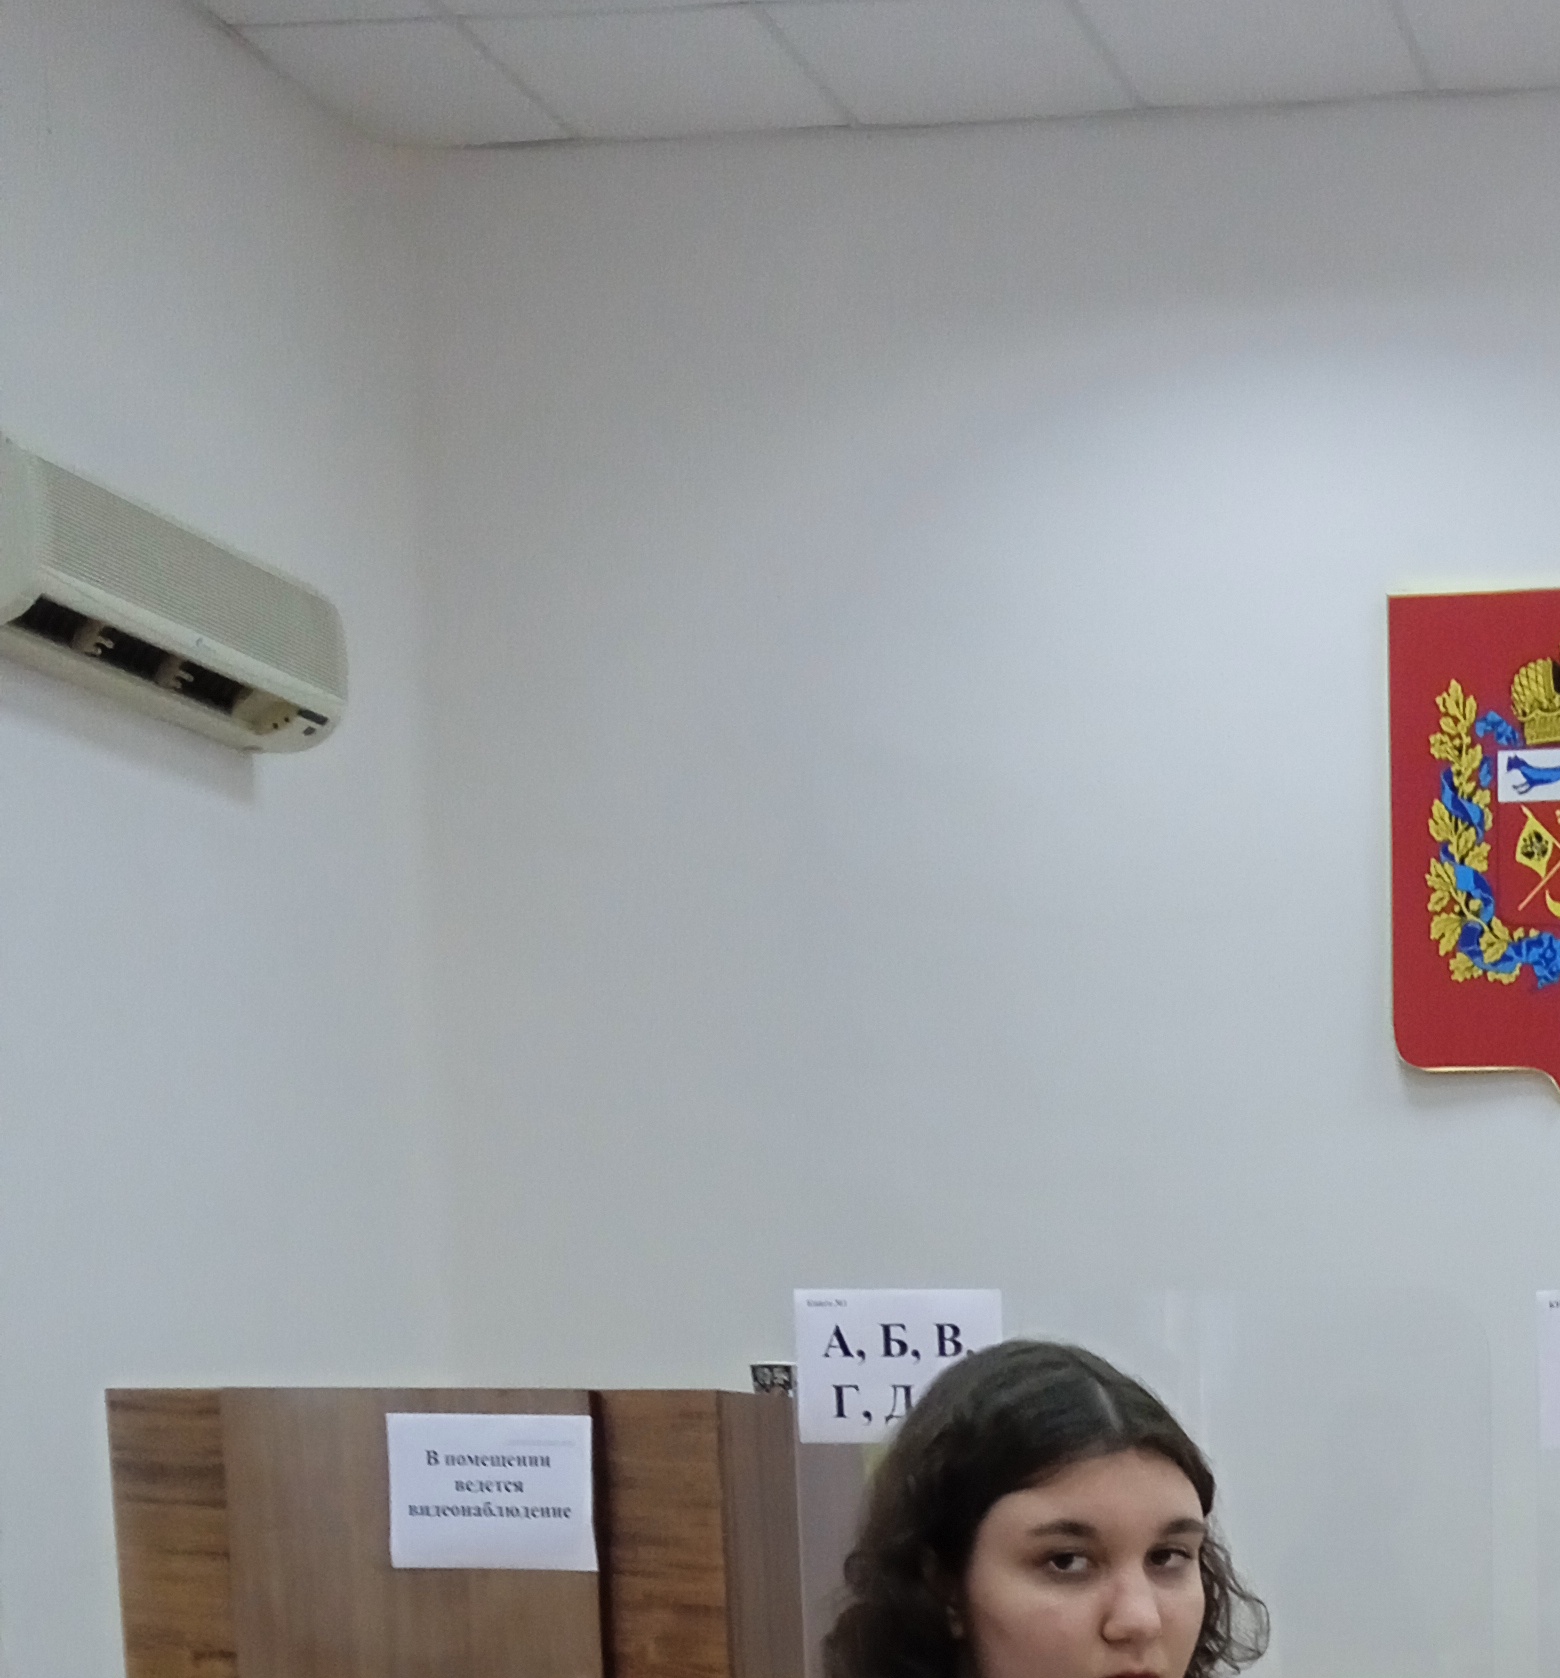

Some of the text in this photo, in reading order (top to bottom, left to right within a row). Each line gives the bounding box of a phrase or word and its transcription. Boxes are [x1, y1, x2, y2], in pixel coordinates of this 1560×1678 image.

[426, 1450, 552, 1469] В помещении
[454, 1479, 525, 1494] ведется
[408, 1501, 573, 1520] видеонаблюдение
